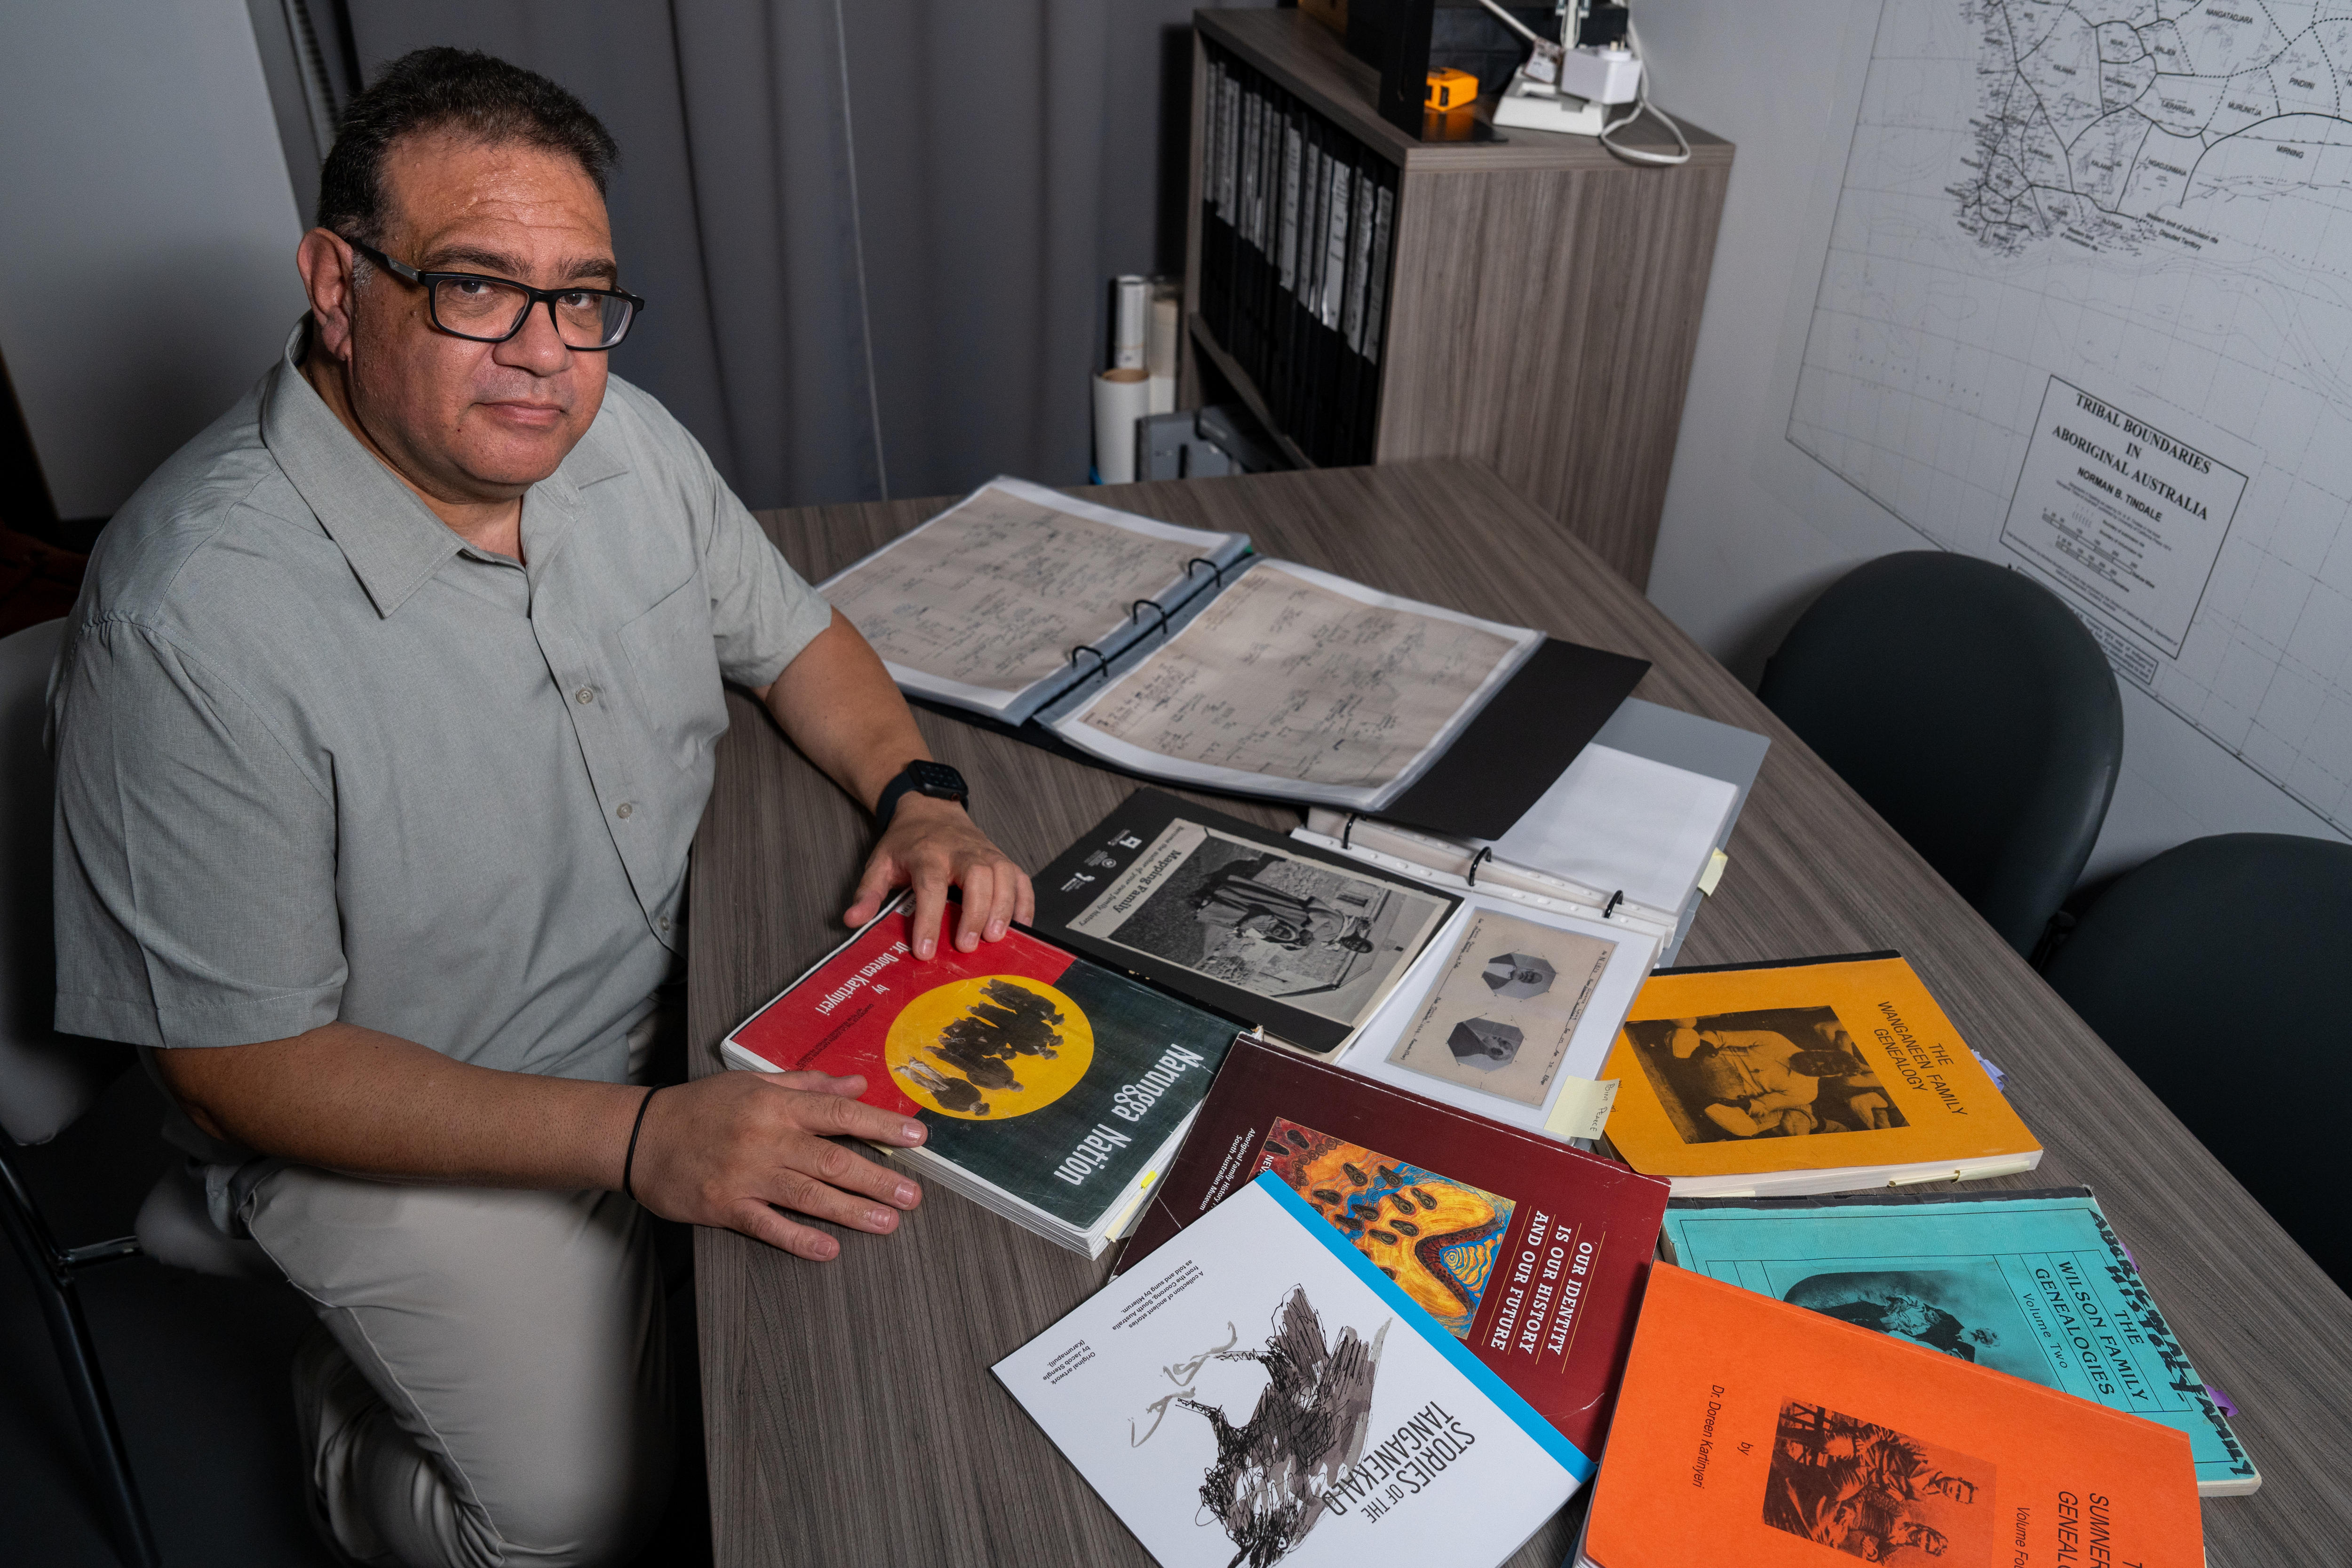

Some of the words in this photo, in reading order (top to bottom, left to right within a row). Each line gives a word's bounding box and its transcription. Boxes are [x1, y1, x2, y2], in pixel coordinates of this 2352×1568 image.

[2276, 145, 2304, 159] MIRNING
[2076, 393, 2121, 427] TRIBAL
[2123, 419, 2212, 475] BOUNDARIES
[2126, 442, 2142, 459] IN
[2052, 425, 2130, 477] ABORIGINAL
[2131, 470, 2208, 520] AUSTRALIA
[2077, 467, 2114, 494] NORMAN
[2114, 489, 2122, 500] B.
[2126, 494, 2162, 522] TINDALE
[1158, 843, 1167, 852] the
[1140, 849, 1182, 885] Mapping
[1143, 851, 1159, 868] author
[1113, 884, 1126, 895] own
[1126, 872, 1138, 885] your
[1097, 893, 1116, 911] family
[1113, 885, 1148, 913] Family
[1079, 910, 1101, 926] history
[889, 941, 912, 952] Dr.
[866, 953, 899, 977] Doreen
[815, 974, 870, 1016] Kartinyeri
[871, 984, 890, 995] by
[1874, 1029, 1928, 1091] GENEALOGY
[1878, 1002, 1934, 1069] WANGANEEN
[1927, 1074, 1968, 1115] FAMILY
[1929, 1043, 1954, 1066] THE
[1111, 1043, 1204, 1122] Narungga
[1602, 1083, 1615, 1101] POINT
[1590, 1106, 1607, 1132] PEARCE
[1053, 1123, 1132, 1186] Nation
[1229, 1135, 1242, 1154] South
[1237, 1128, 1255, 1162] Aboriginal
[1214, 1154, 1232, 1185] Australian
[1225, 1161, 1240, 1181] Family
[1200, 1186, 1217, 1210] Museum
[1214, 1182, 1230, 1203] History
[1527, 1210, 1549, 1246] AND
[1555, 1225, 1572, 1242] IS
[1176, 1265, 1186, 1275] told
[1513, 1250, 1536, 1283] OUR
[1543, 1247, 1564, 1280] OUR
[1575, 1242, 1593, 1275] OUR
[1165, 1273, 1175, 1282] and
[1185, 1266, 1199, 1276] from
[1151, 1281, 1164, 1292] sung
[1152, 1282, 1176, 1299] Coorong,
[1174, 1275, 1199, 1294] collection
[1121, 1296, 1145, 1313] Milerum.
[1136, 1299, 1153, 1312] South
[1148, 1298, 1167, 1314] ancient
[1112, 1311, 1136, 1330] Australia
[1129, 1313, 1147, 1328] stories
[1490, 1287, 1524, 1351] FUTURE
[1519, 1283, 1553, 1354] HISTORY
[1547, 1279, 1582, 1355] IDENTITY
[2114, 1310, 2145, 1345] THE
[2023, 1293, 2051, 1338] Volume
[2050, 1343, 2068, 1369] Two
[2035, 1268, 2114, 1395] GENEALOGIES
[2058, 1261, 2107, 1330] WILSON
[2100, 1336, 2149, 1401] FAMILY
[1065, 1352, 1081, 1365] Jacob
[1073, 1352, 1096, 1373] Original
[1042, 1363, 1065, 1381] Stengle
[1050, 1367, 1073, 1385] artwork
[1711, 1385, 1724, 1399] Dr.
[1703, 1401, 1722, 1438] Doreen
[2193, 1384, 2256, 1476] FAMILY
[1321, 1401, 1454, 1516] TANGANEKALD
[1396, 1421, 1475, 1494] STORIES
[1737, 1441, 1754, 1456] by
[1692, 1440, 1714, 1489] Kartinyeri
[1388, 1484, 1405, 1505] OF
[1360, 1499, 1390, 1524] THE
[2015, 1507, 2030, 1547] Volume
[2058, 1491, 2078, 1568] GENEAL
